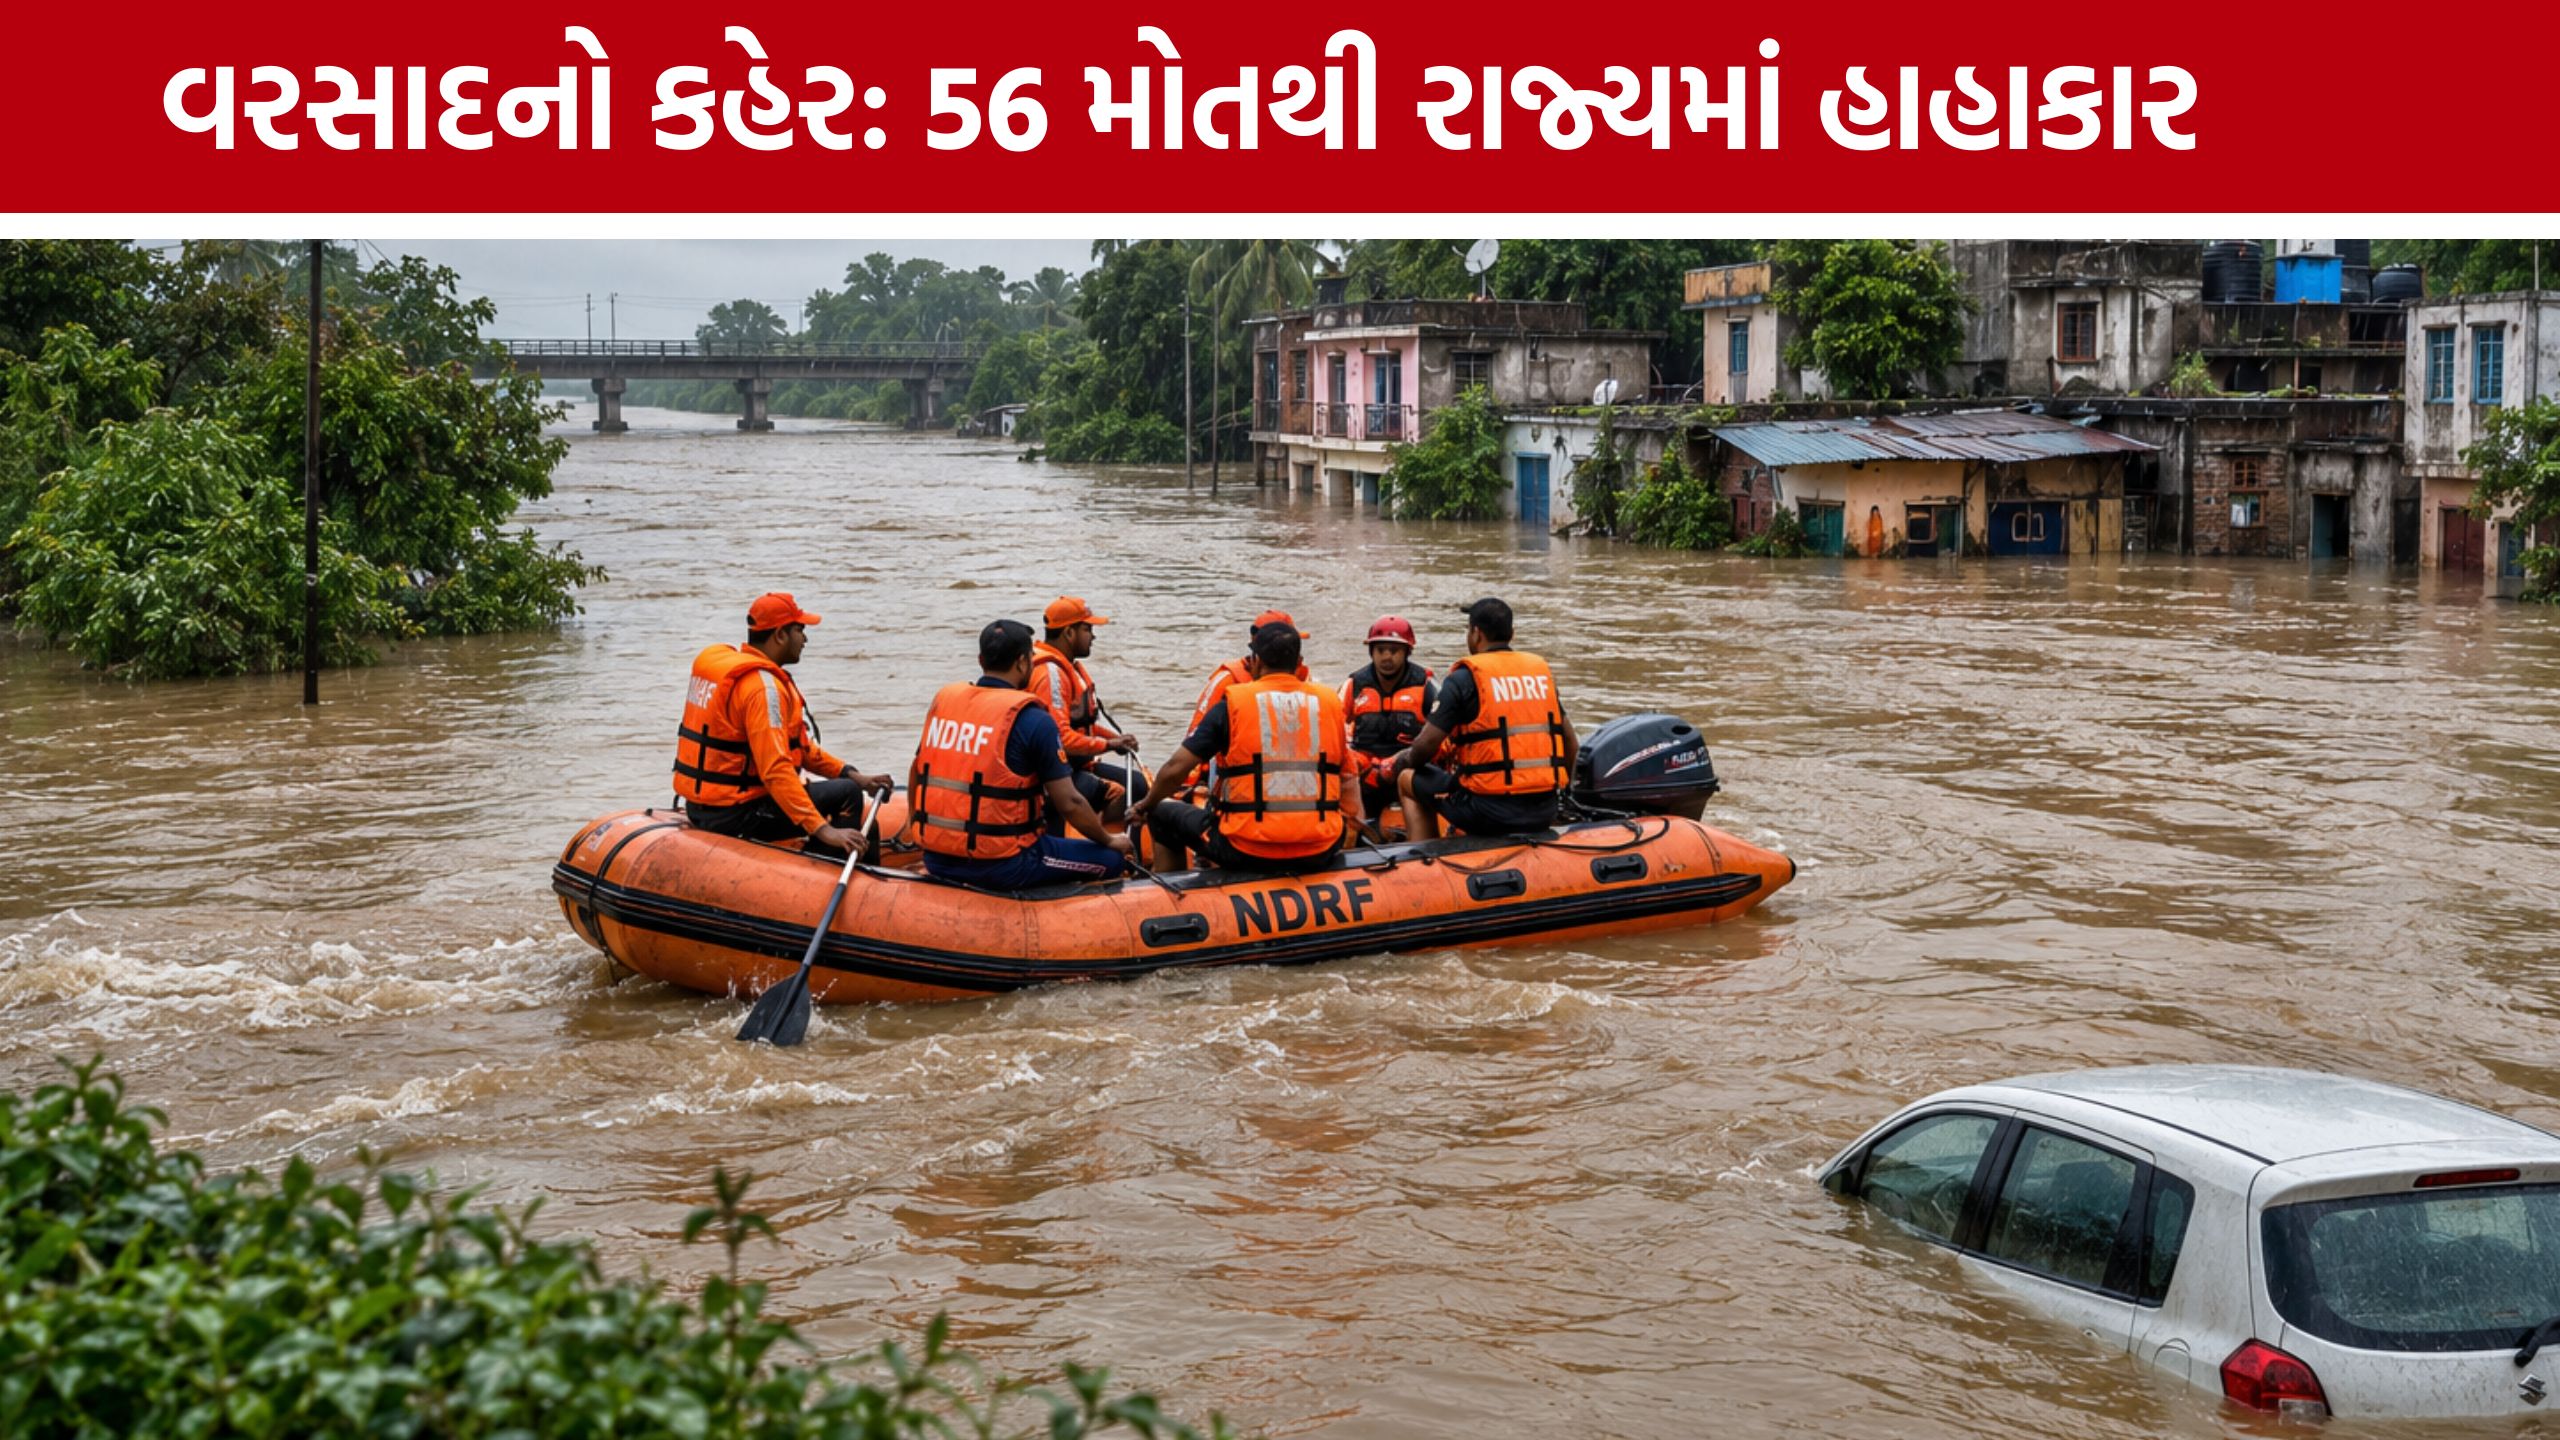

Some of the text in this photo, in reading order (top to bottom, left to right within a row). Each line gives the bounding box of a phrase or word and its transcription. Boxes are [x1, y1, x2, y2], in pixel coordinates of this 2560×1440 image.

[1490, 675, 1548, 703] NDRF
[926, 716, 993, 756] NDRF
[1229, 878, 1374, 937] NDRF
